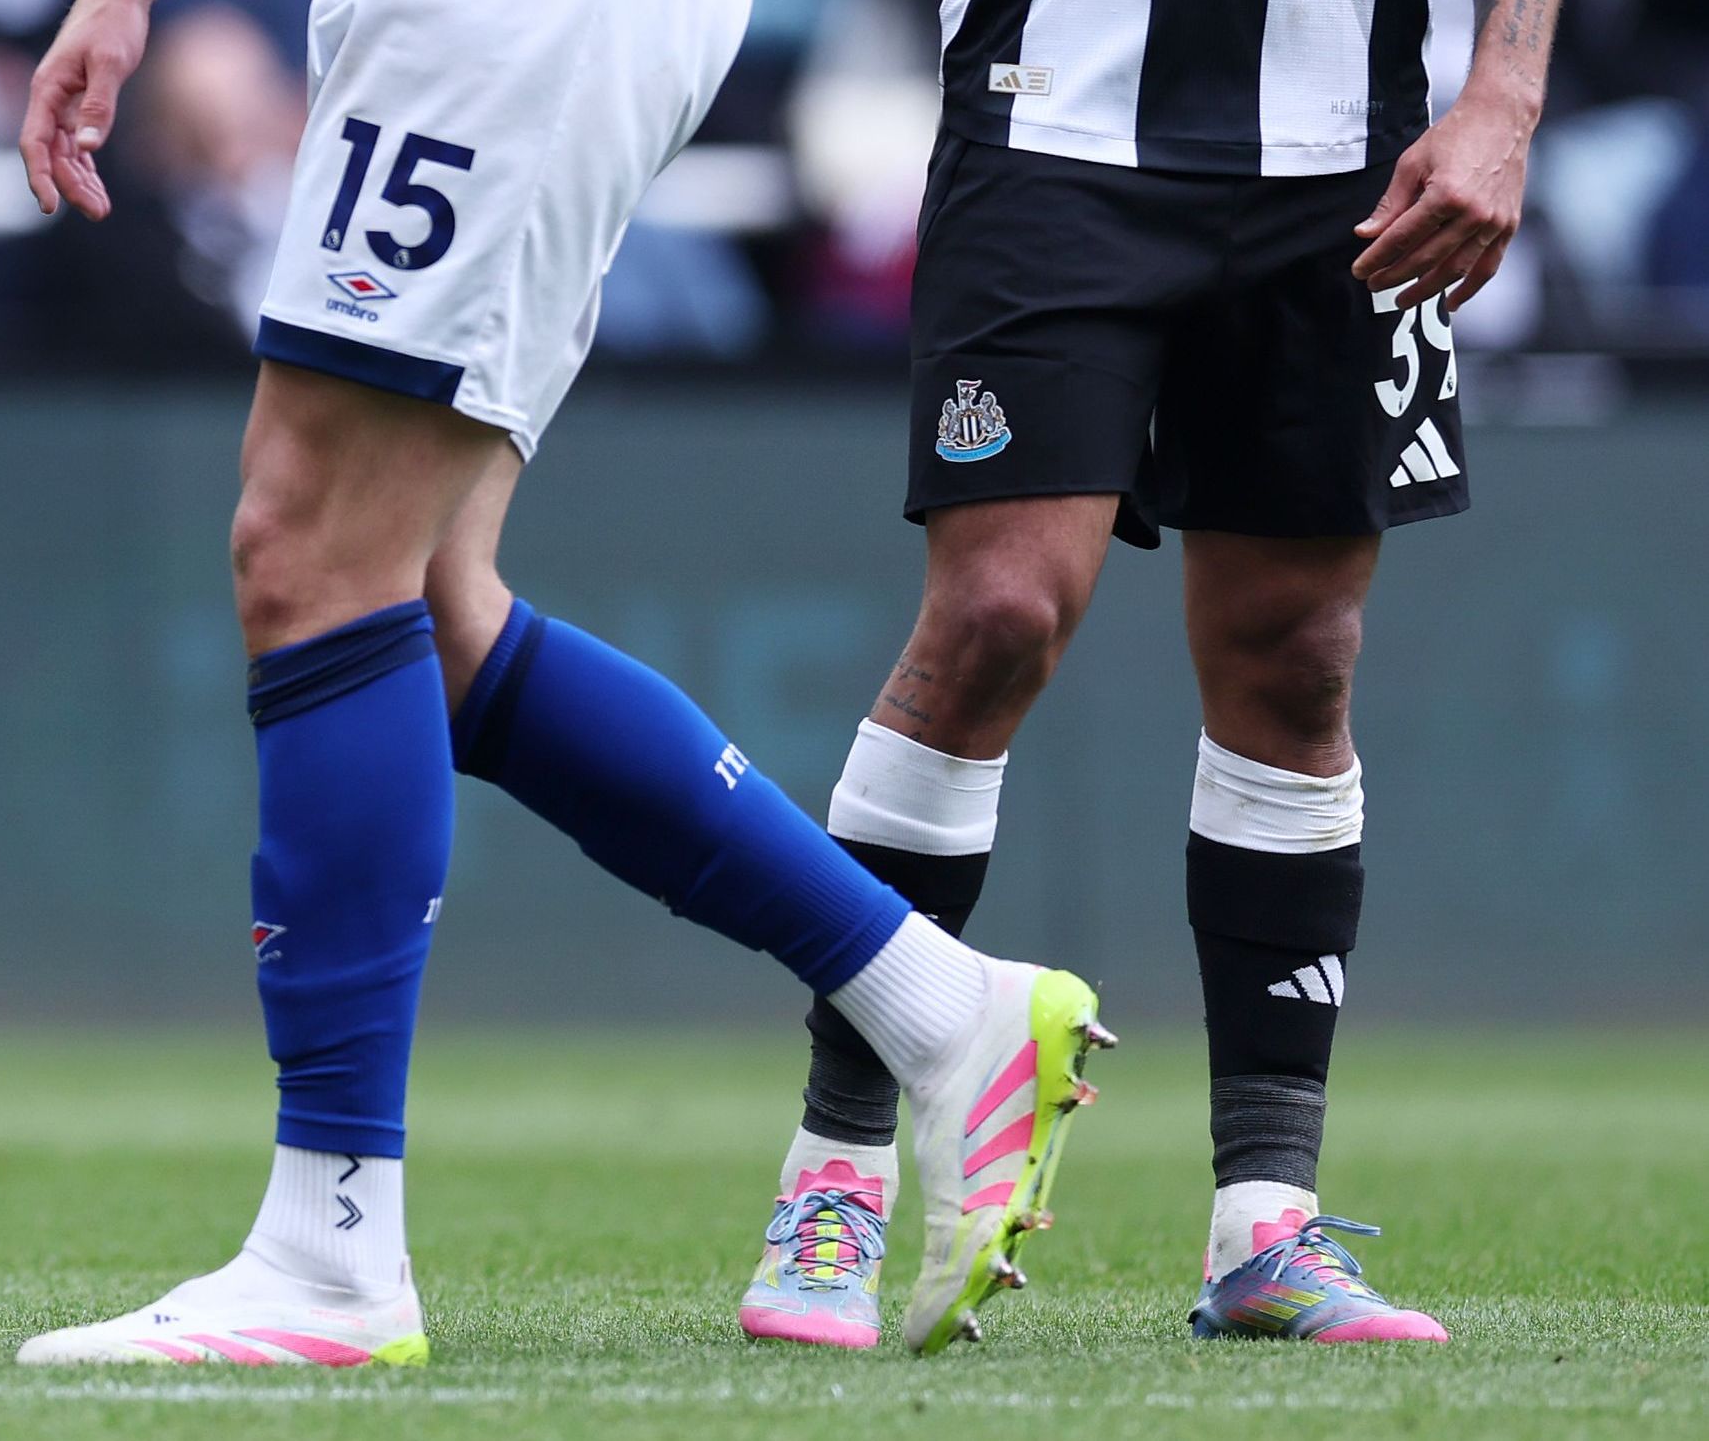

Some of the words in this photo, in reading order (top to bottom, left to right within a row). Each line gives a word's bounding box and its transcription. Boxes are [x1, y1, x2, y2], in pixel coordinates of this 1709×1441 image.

[320, 116, 475, 271] 15
[325, 298, 379, 323] umbro
[1370, 276, 1458, 418] 39
